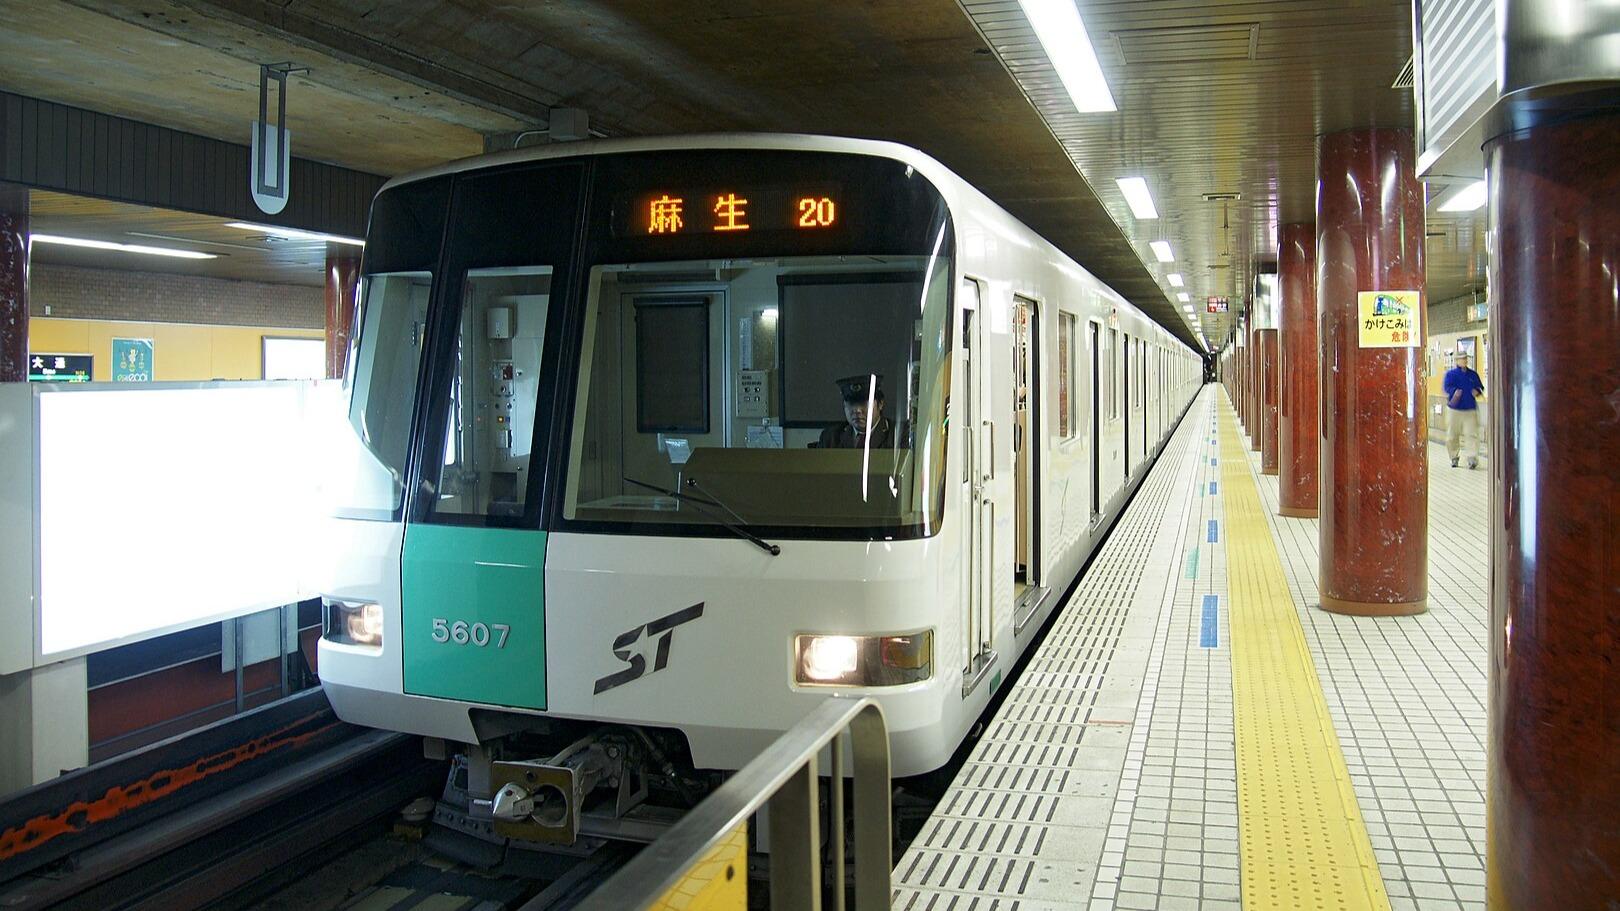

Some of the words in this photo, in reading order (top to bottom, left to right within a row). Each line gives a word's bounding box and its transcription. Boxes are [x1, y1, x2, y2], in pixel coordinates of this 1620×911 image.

[649, 194, 749, 232] 麻生
[799, 198, 834, 226] 20
[431, 618, 511, 648] 5607
[593, 601, 705, 695] ST
